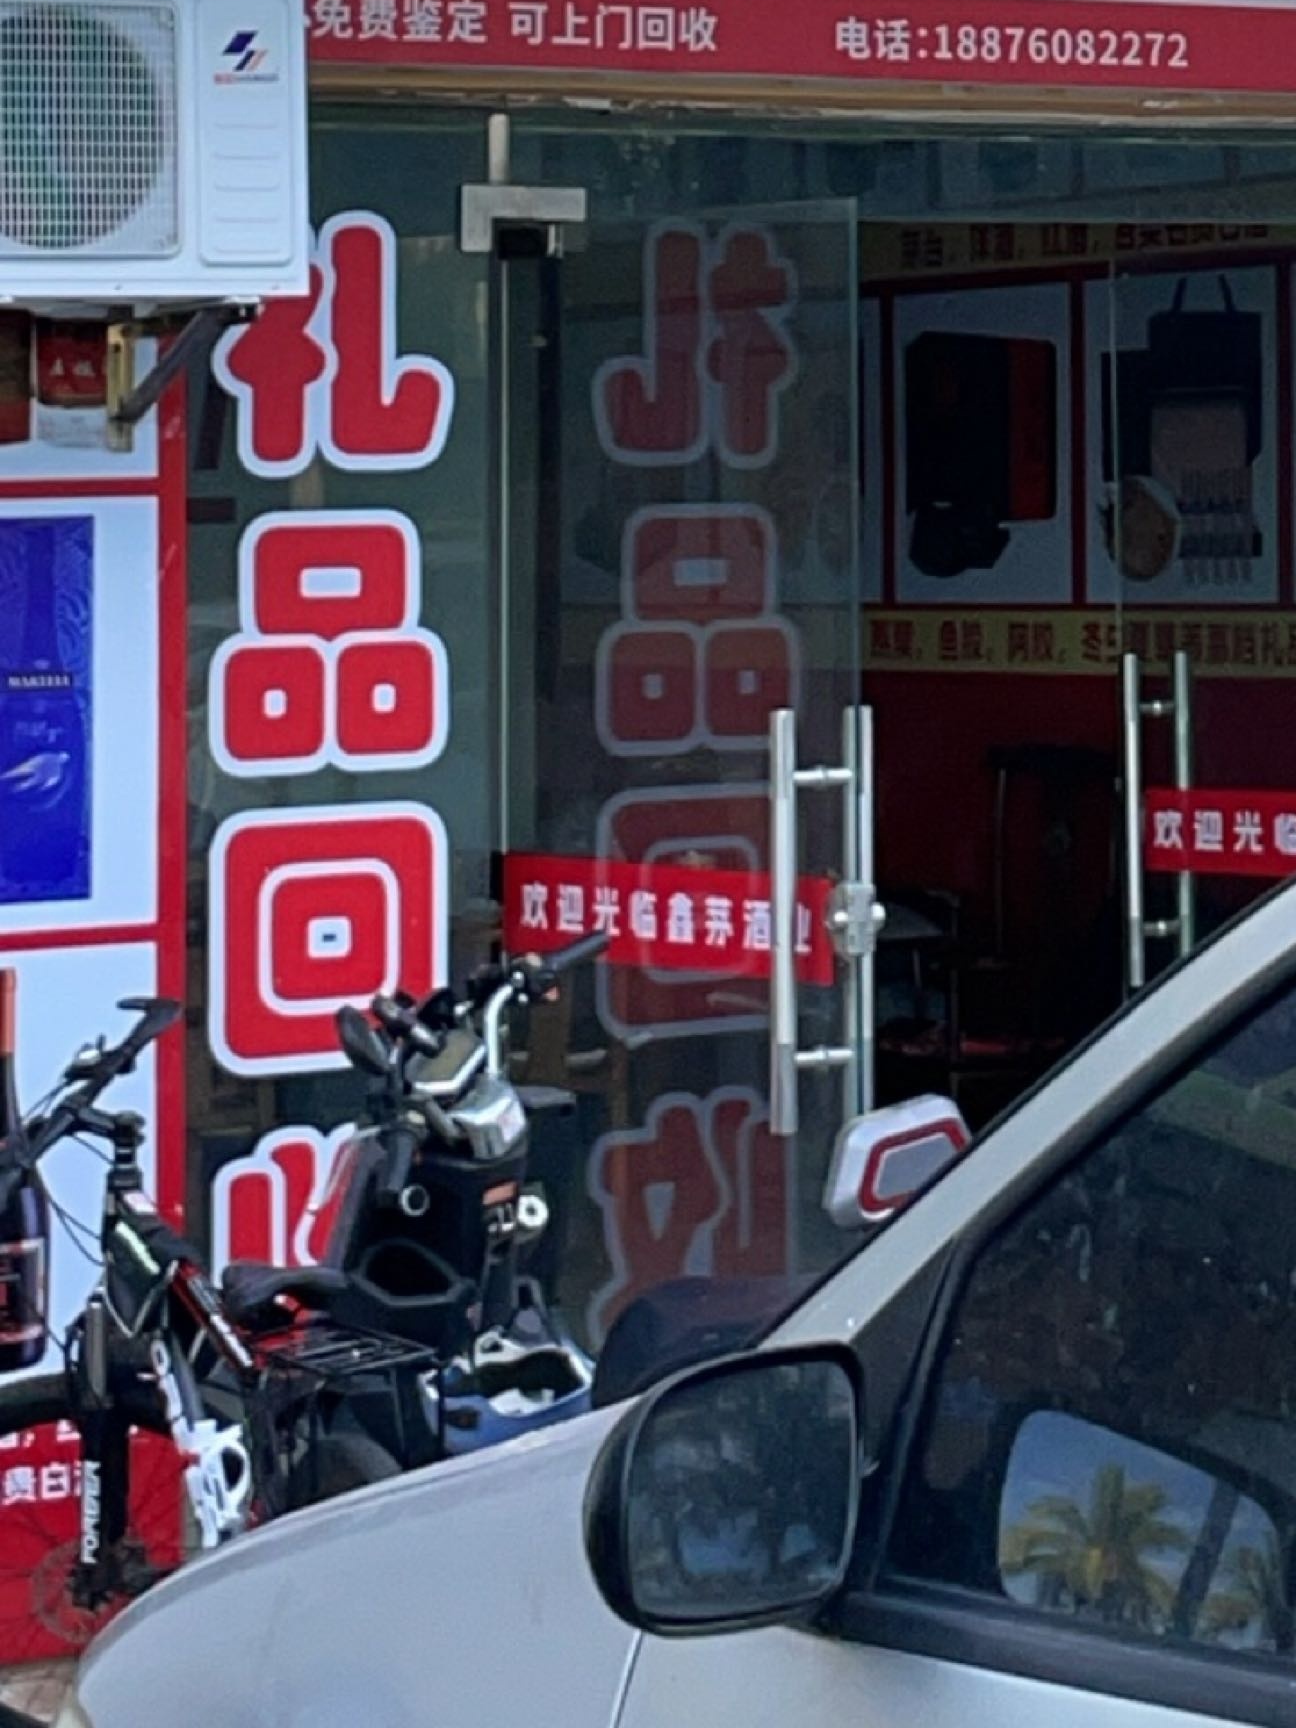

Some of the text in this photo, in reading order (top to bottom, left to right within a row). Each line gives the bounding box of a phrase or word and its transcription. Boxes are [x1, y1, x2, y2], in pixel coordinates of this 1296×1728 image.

[508, 2, 718, 53] 可上门回收
[834, 15, 1190, 68] 电话:18876082272
